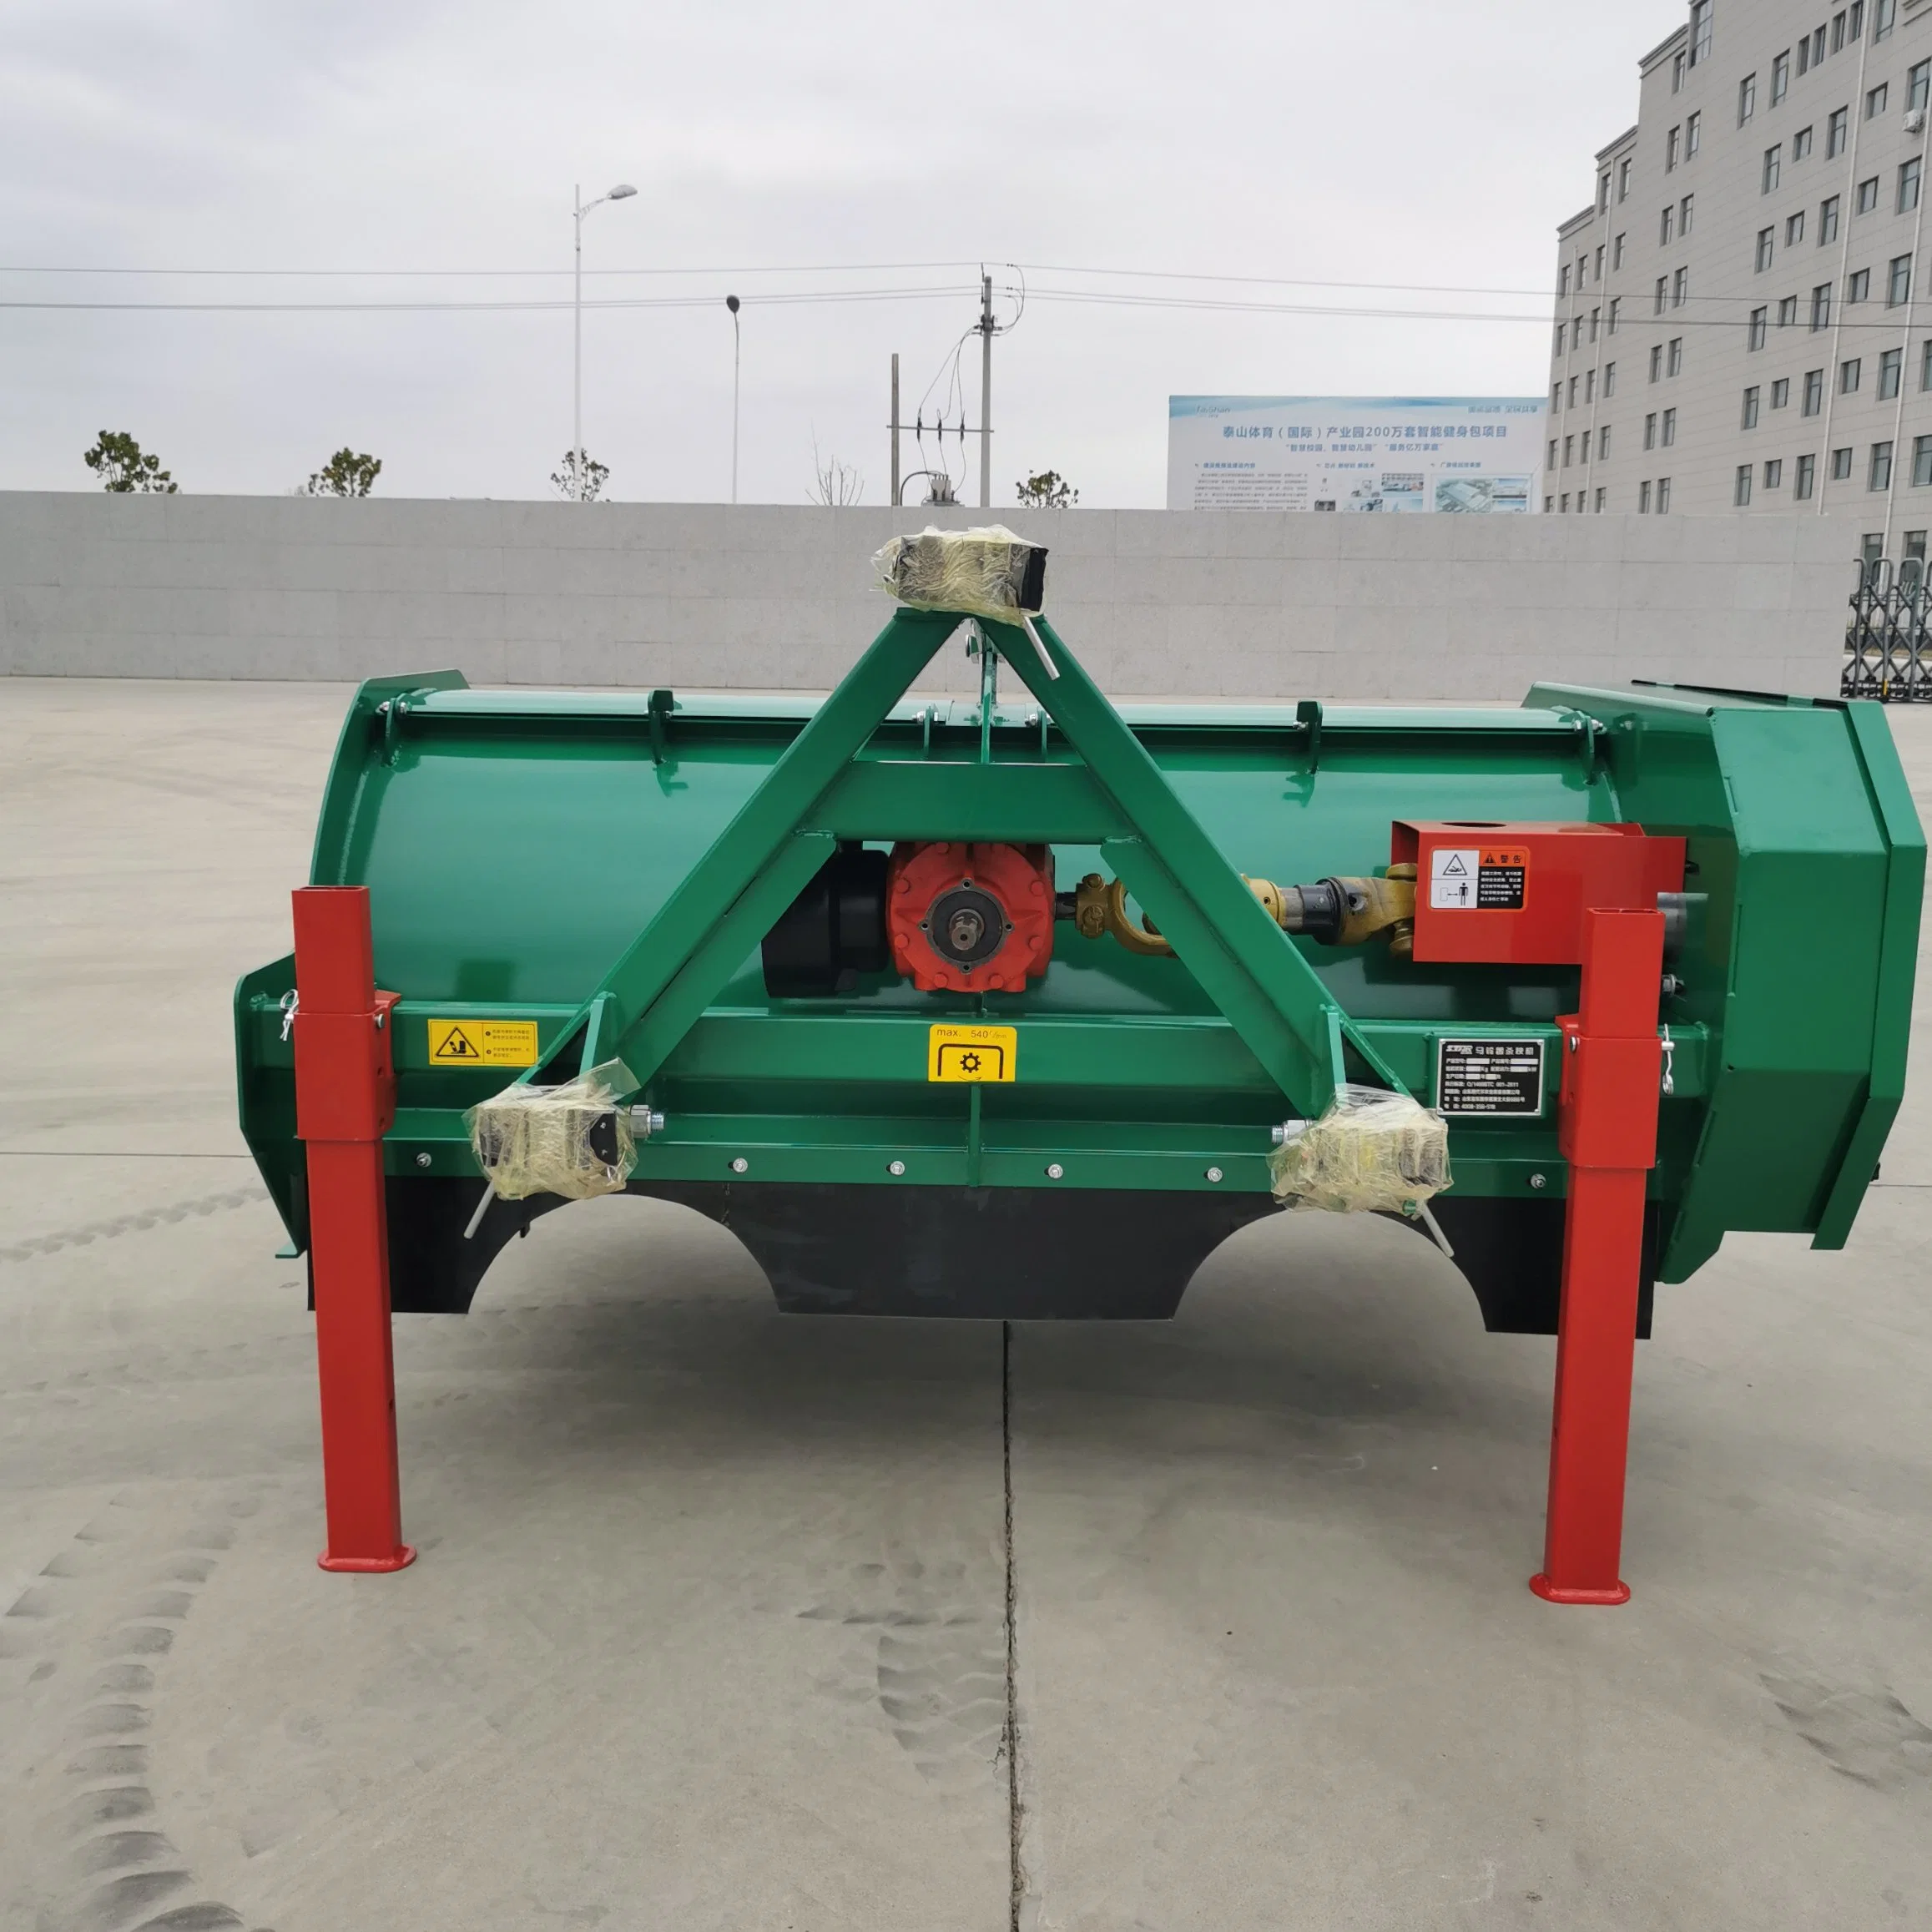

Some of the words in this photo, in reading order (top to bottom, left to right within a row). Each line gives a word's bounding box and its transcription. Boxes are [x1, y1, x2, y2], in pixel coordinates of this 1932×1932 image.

[1223, 426, 1507, 439] 泰山体育（国际）产业园200万套智能健身包项目
[1501, 854, 1521, 864] 警告
[936, 1028, 961, 1037] max.
